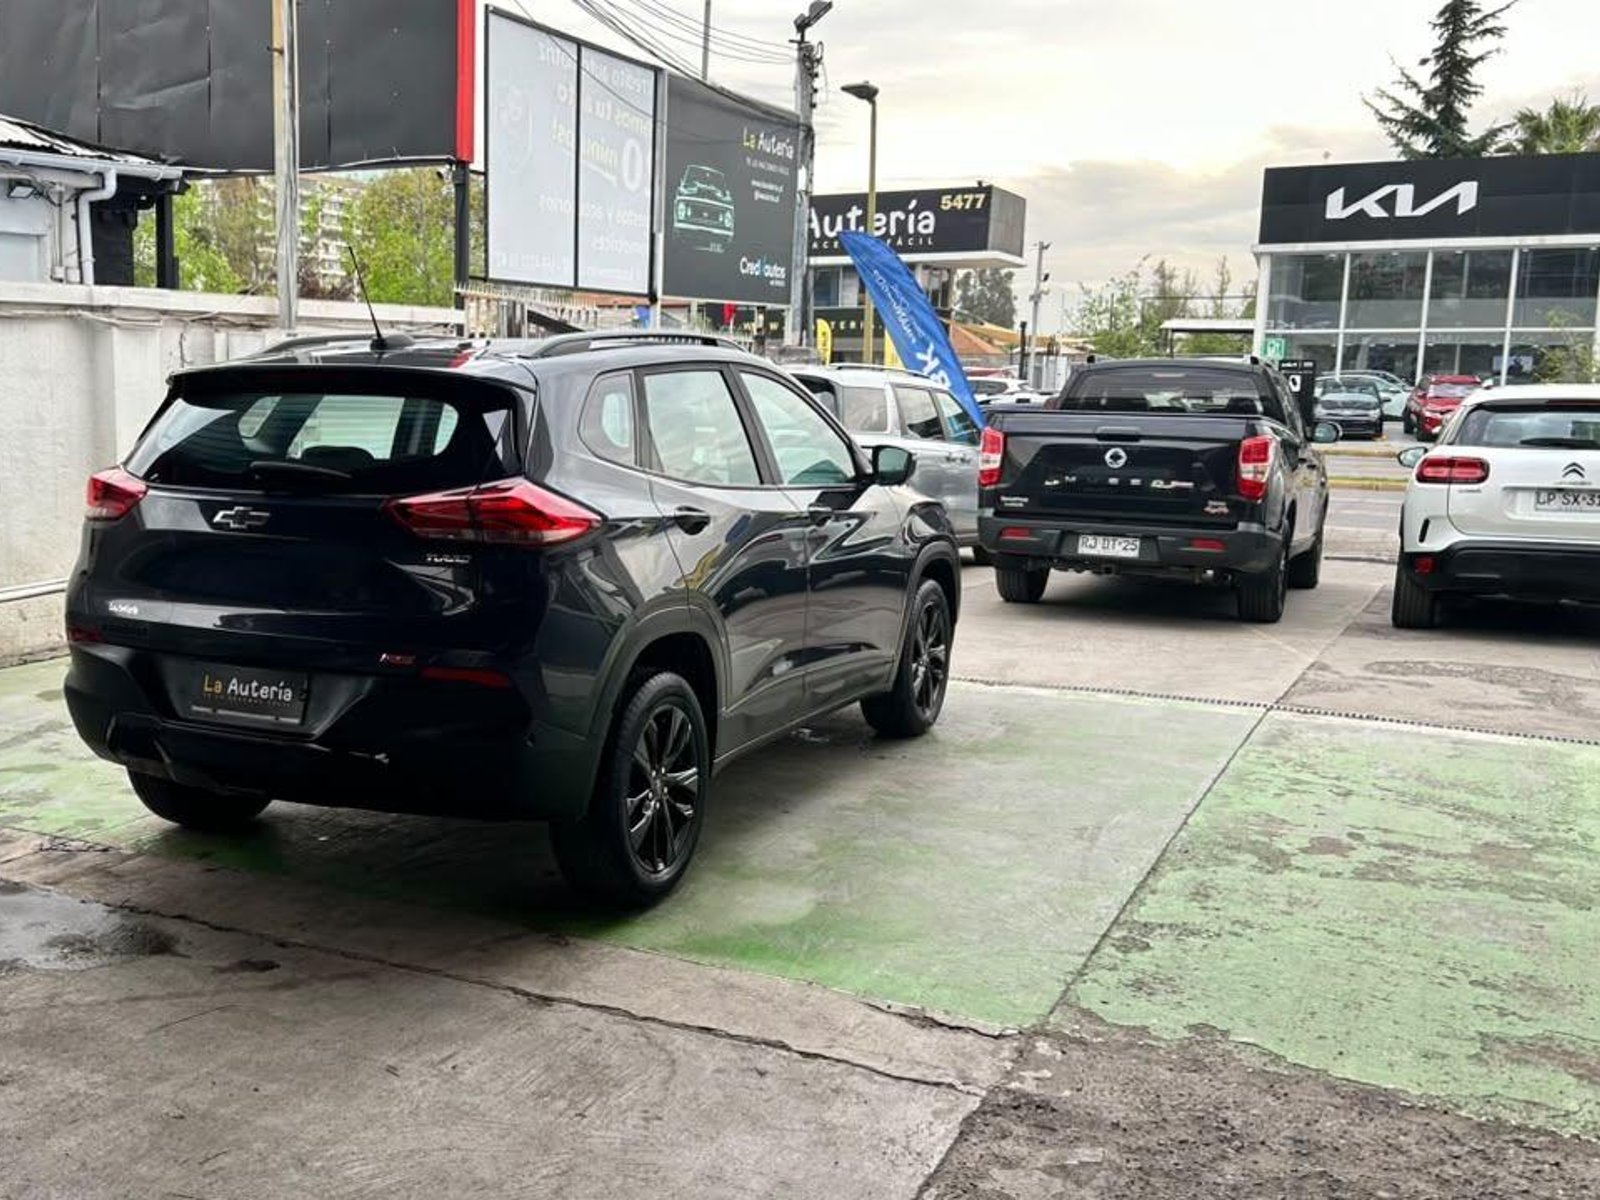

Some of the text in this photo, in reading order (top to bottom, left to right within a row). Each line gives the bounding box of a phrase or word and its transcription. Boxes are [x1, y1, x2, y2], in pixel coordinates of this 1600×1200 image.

[743, 127, 756, 150] La
[940, 193, 986, 211] 5477
[1325, 181, 1478, 219] KIA
[203, 674, 223, 694] La
[227, 677, 293, 702] Autería
